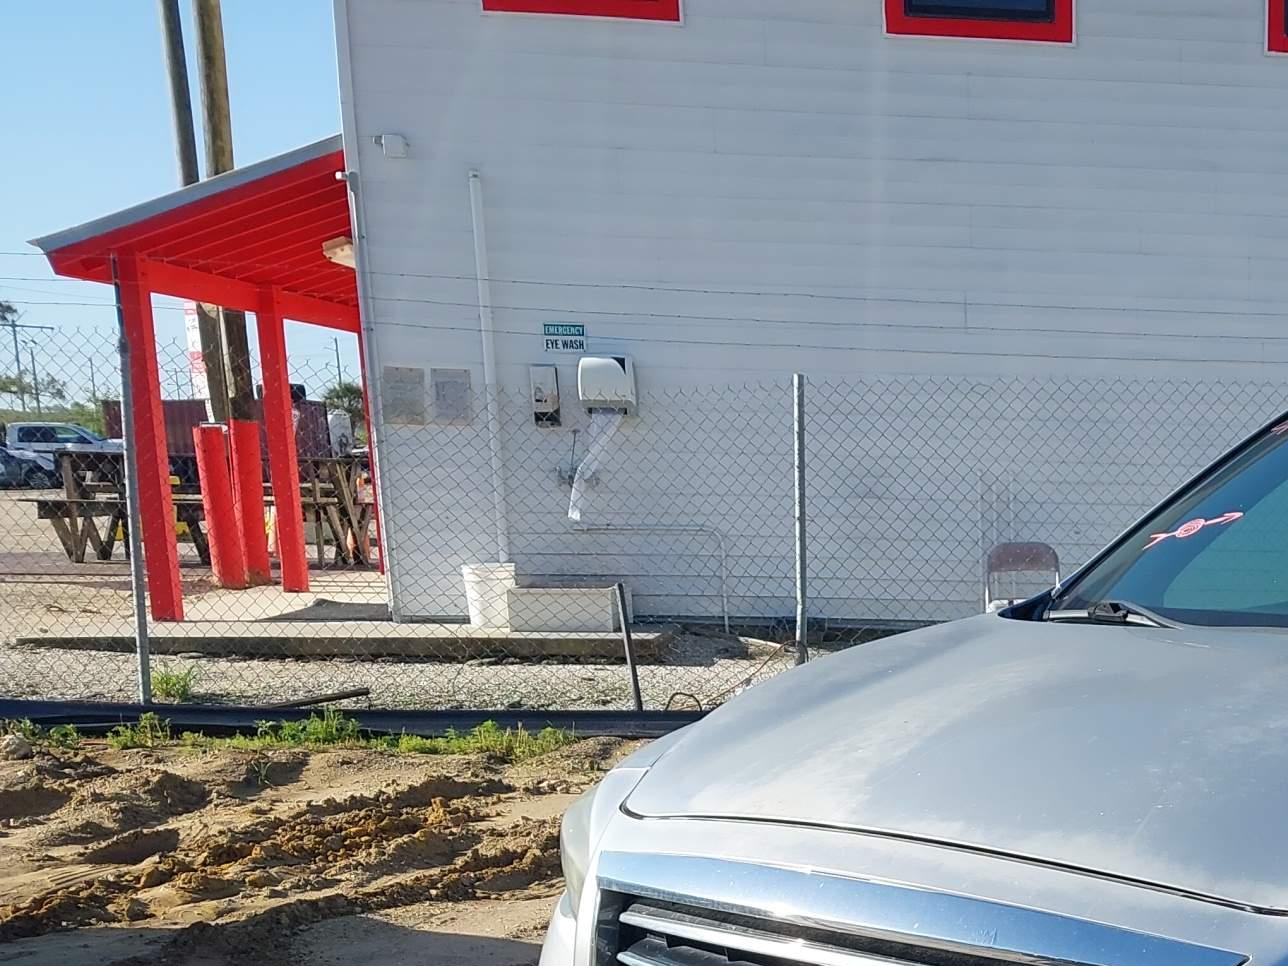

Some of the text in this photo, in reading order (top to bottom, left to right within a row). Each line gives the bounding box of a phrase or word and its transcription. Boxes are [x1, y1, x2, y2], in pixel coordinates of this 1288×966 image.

[545, 325, 583, 335] EMERGENCY
[545, 339, 585, 350] EYE WASH
